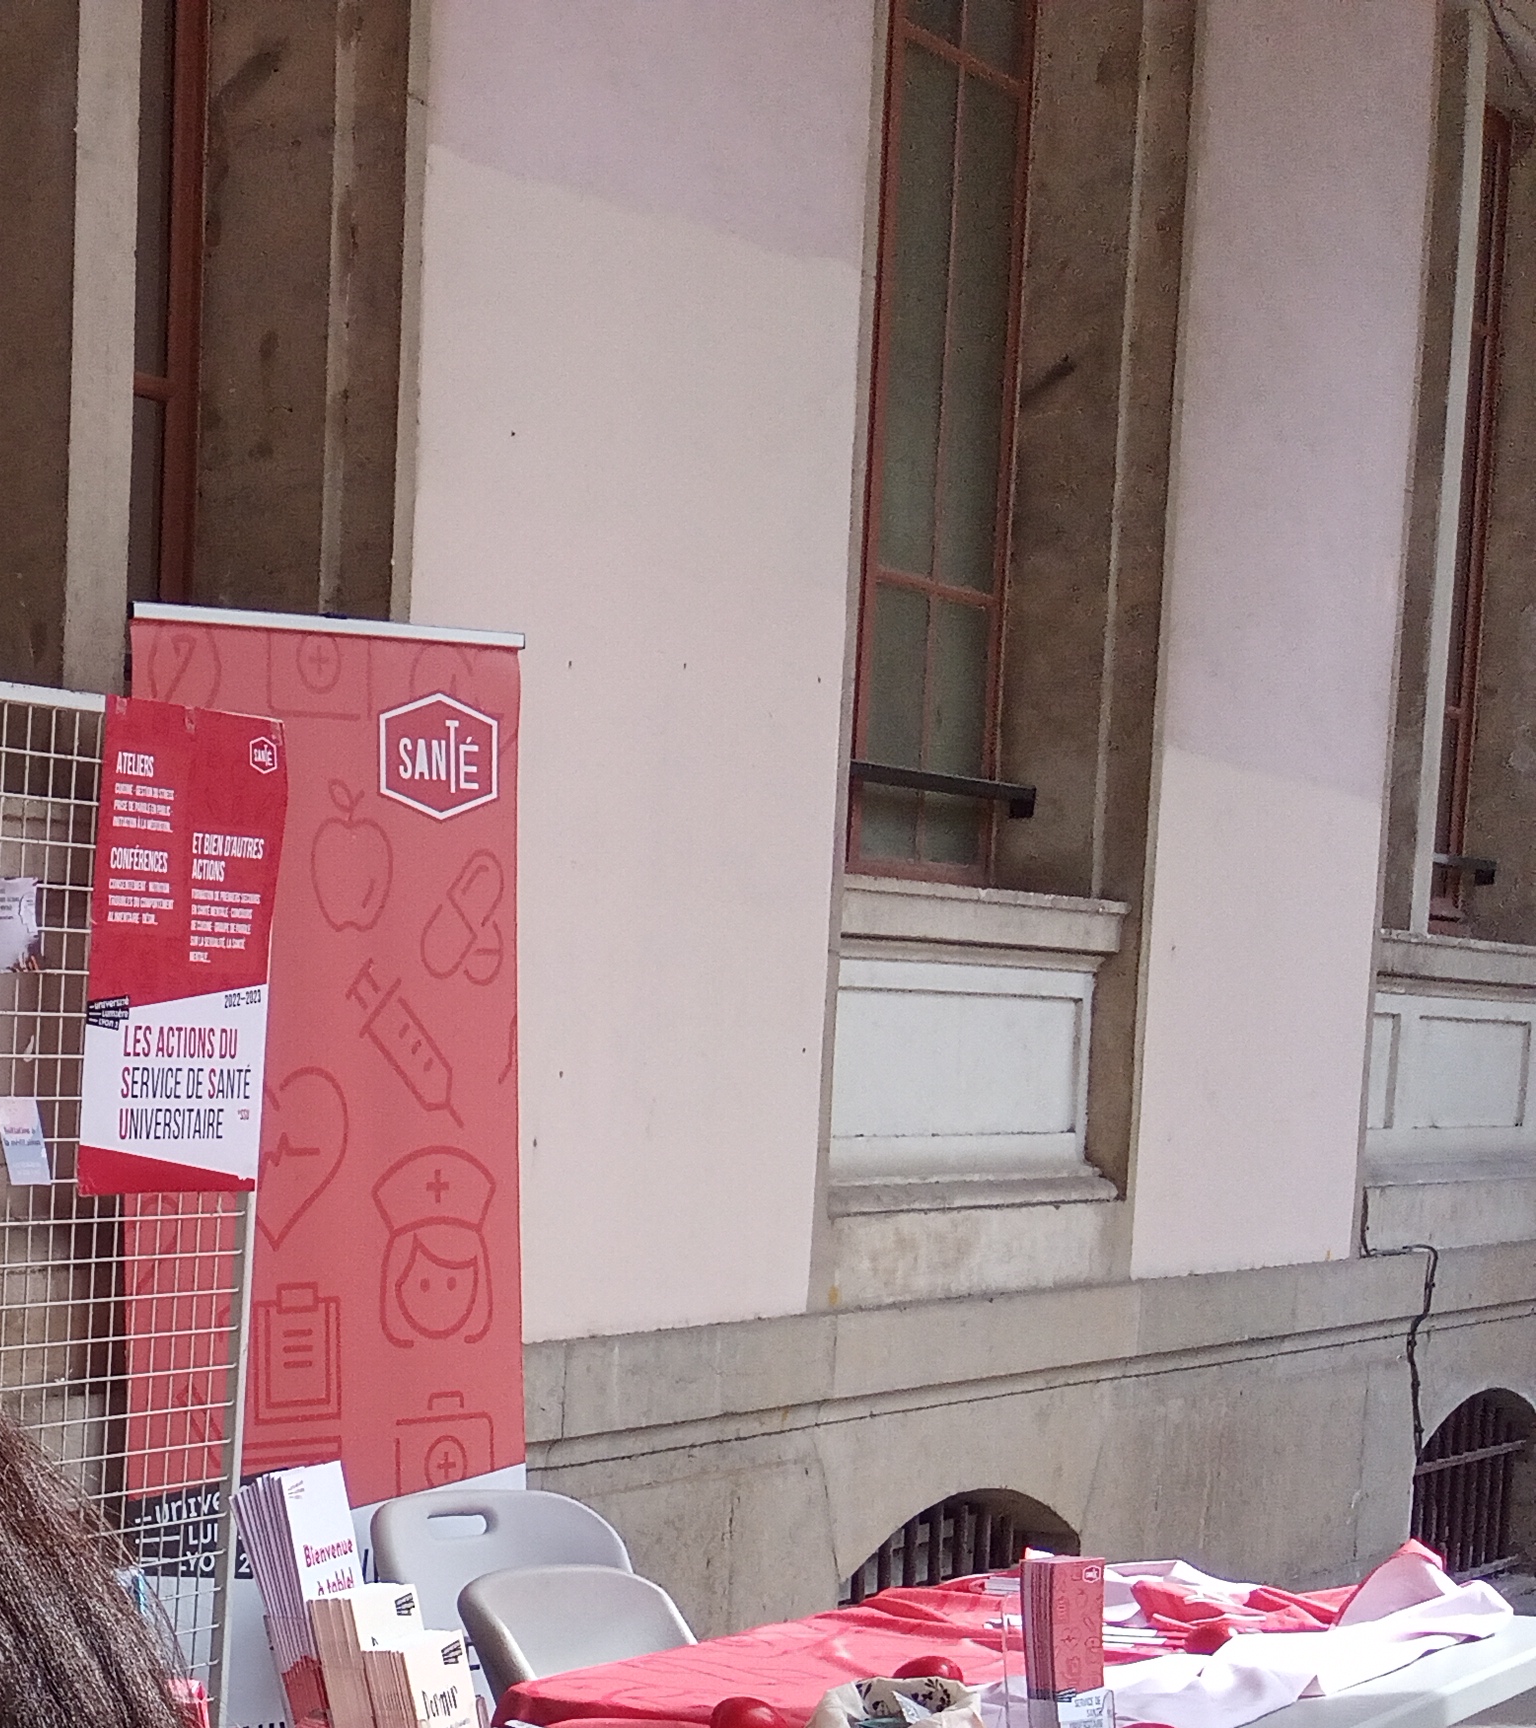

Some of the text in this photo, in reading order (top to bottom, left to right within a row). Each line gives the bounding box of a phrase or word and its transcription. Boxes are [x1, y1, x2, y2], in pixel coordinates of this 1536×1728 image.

[115, 751, 155, 778] ATELIERS
[398, 719, 480, 794] SANTÉ
[109, 844, 169, 874] CONFÉRENCES
[191, 832, 265, 860] ET BIEN D'AUTRES
[191, 858, 226, 883] ACTIONS
[122, 1024, 239, 1060] LES ACTIONS DU
[120, 1064, 252, 1100] SERVICE DE SANTÉ
[119, 1107, 225, 1140] UNIVERSITAIRE
[303, 1538, 354, 1568] Bienvenue
